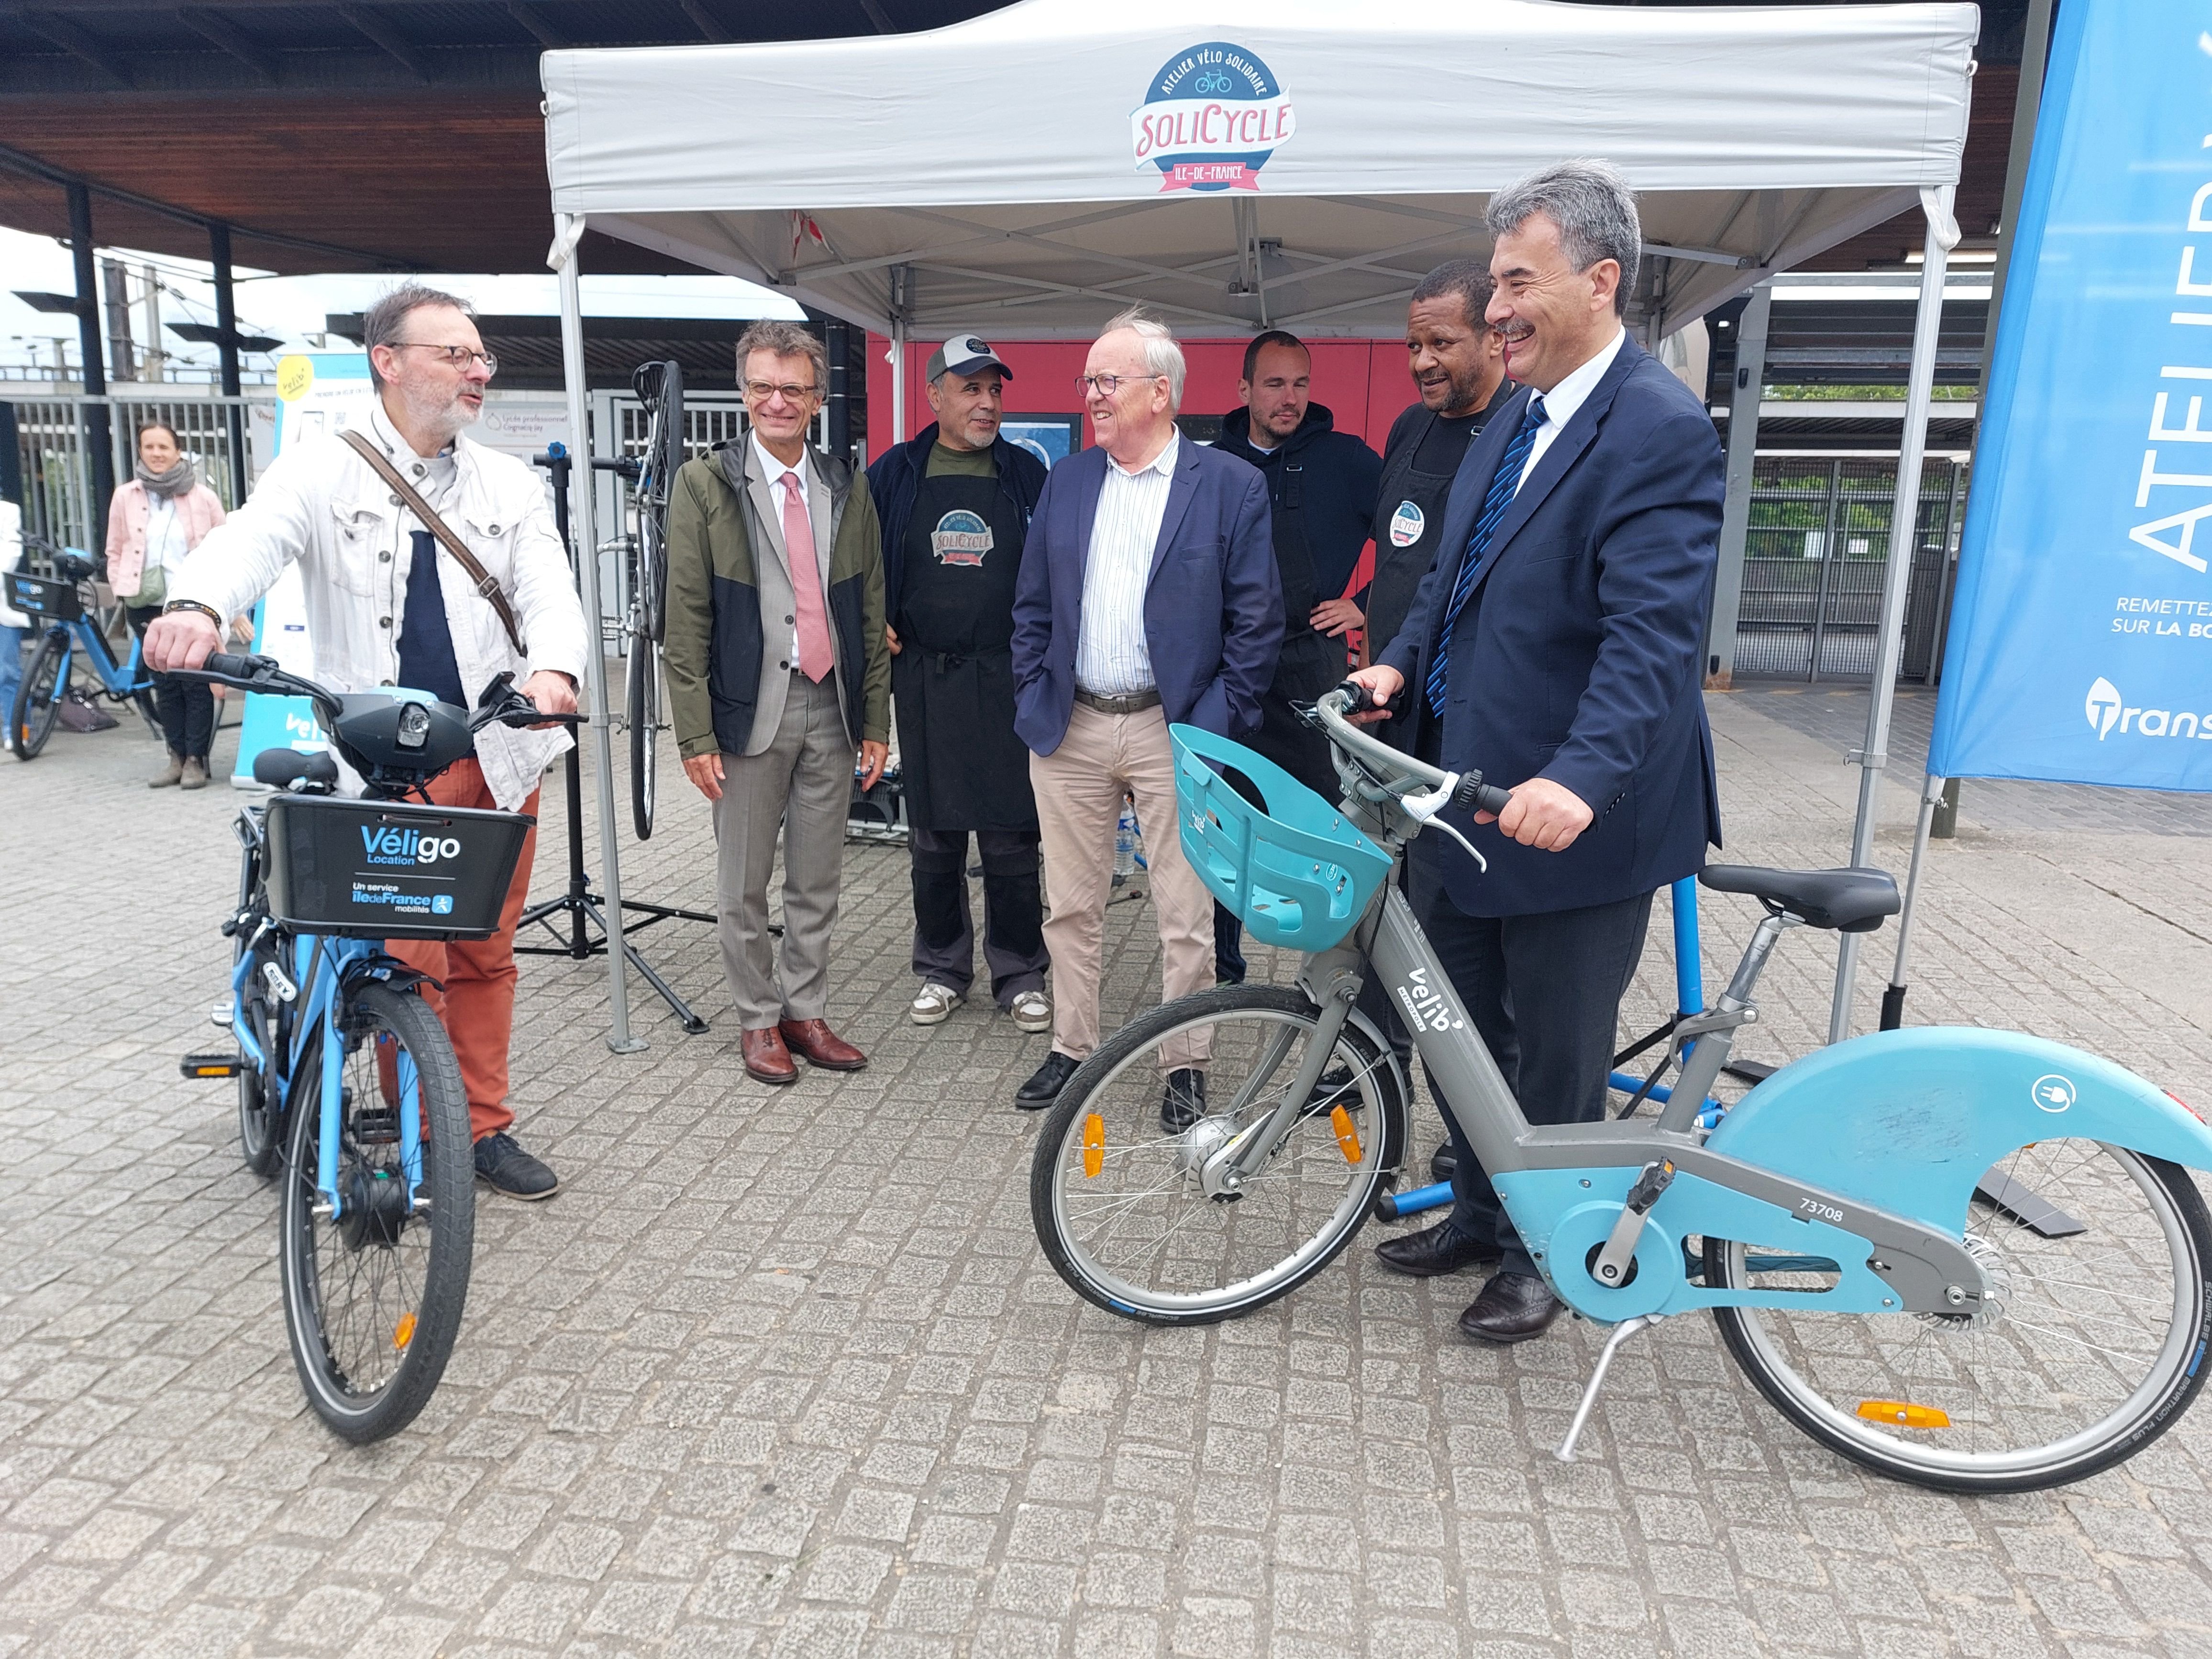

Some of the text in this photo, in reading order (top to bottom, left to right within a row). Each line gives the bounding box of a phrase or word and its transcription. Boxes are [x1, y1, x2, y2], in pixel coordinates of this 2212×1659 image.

[1161, 48, 1268, 96] ATELIER VÉLO SOLIDAIRE
[1136, 103, 1292, 157] SOLICYCLE
[1174, 165, 1243, 181] ILE-DE-FRANCE
[936, 533, 991, 550] SOLICYCLE
[2111, 618, 2150, 634] SUR
[2155, 620, 2181, 636] LA
[360, 825, 461, 863] Véligo
[367, 853, 415, 866] Location
[352, 882, 399, 893] Un service
[395, 904, 430, 914] mobilités
[1399, 989, 1424, 1029] MÉTROPOLE
[1799, 1197, 1844, 1222] 73708
